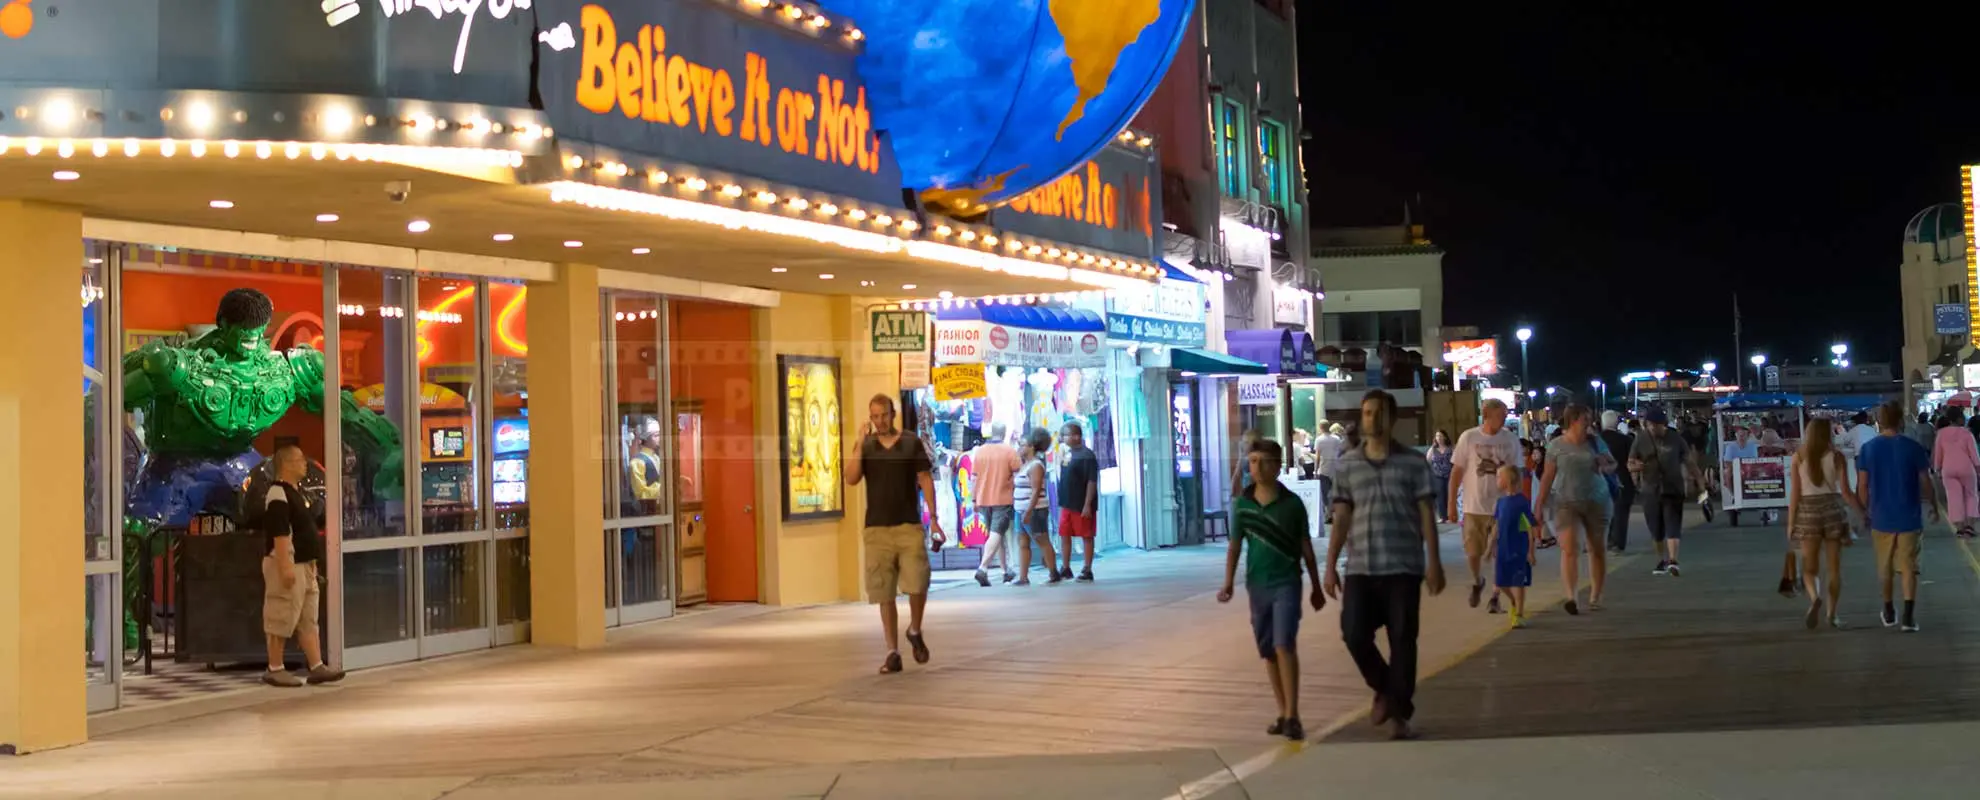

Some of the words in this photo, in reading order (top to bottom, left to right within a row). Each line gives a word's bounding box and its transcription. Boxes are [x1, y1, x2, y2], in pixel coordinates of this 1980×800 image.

[576, 4, 735, 136] Believe
[740, 52, 772, 147] It
[776, 87, 815, 155] or
[1085, 160, 1102, 226] It
[874, 313, 924, 336] ATM
[938, 329, 980, 341] FASHION
[1018, 331, 1048, 353] FASHION
[1050, 335, 1073, 354] ISLAND
[942, 344, 976, 356] ISLAND
[934, 370, 953, 384] FINE
[955, 367, 986, 381] CIGARS
[1240, 383, 1277, 400] MASSAGE
